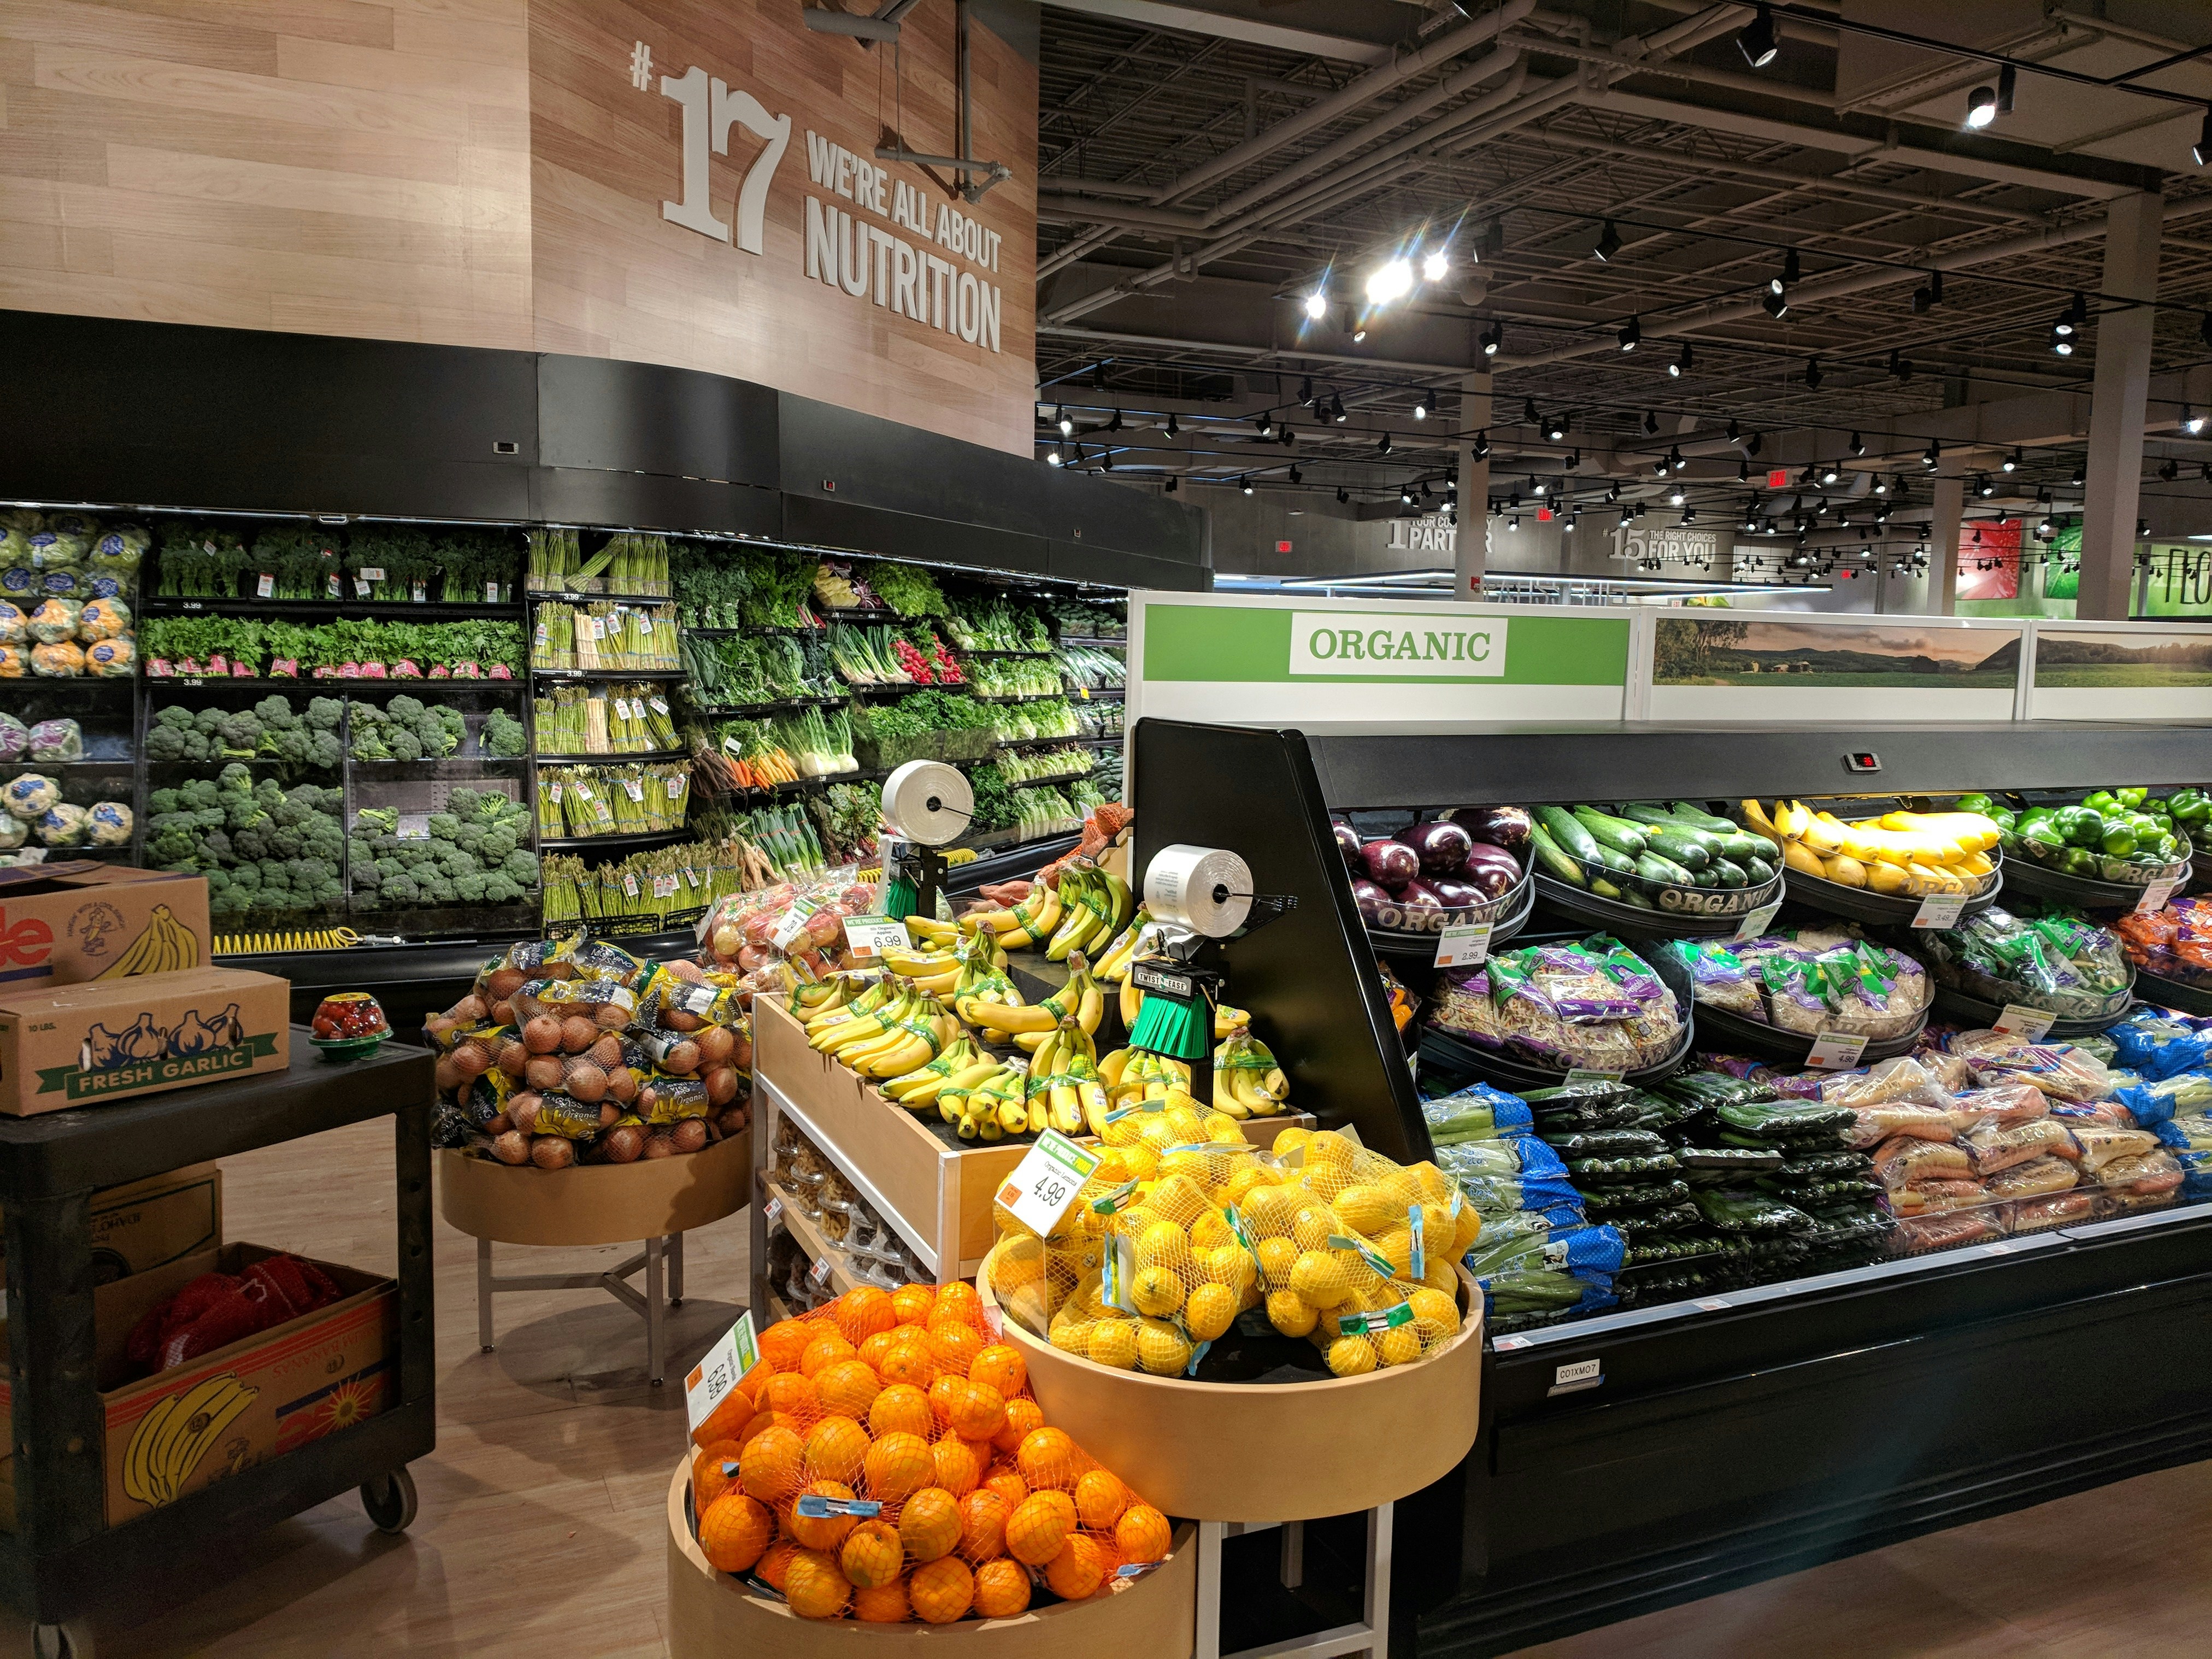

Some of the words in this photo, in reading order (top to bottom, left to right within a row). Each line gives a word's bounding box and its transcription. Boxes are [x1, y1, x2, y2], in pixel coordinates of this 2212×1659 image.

[807, 130, 889, 216] WE'RE
[892, 179, 932, 241] ALL
[935, 202, 1002, 273] ABOUT
[804, 195, 1001, 353] NUTRITION
[1409, 527, 1492, 553] PARTR
[1649, 530, 1663, 540] THE
[1665, 531, 1686, 541] RIGHT
[1687, 532, 1716, 543] CHOICES
[1648, 540, 1680, 561] FOR
[1682, 542, 1716, 563] YOU
[1309, 628, 1491, 661] ORGANIC
[874, 935, 902, 948] 6.99
[1462, 951, 1479, 961] 2.99
[1140, 973, 1160, 983] TWIST
[1838, 1055, 1855, 1063] 4.99
[78, 1067, 153, 1092] FRESH
[162, 1051, 244, 1078] GARLIC
[676, 1091, 705, 1106] Organic
[562, 1109, 597, 1121] Organic
[1044, 1161, 1062, 1176] Organic
[1033, 1176, 1066, 1207] 4.99
[707, 1363, 728, 1401] 6.99
